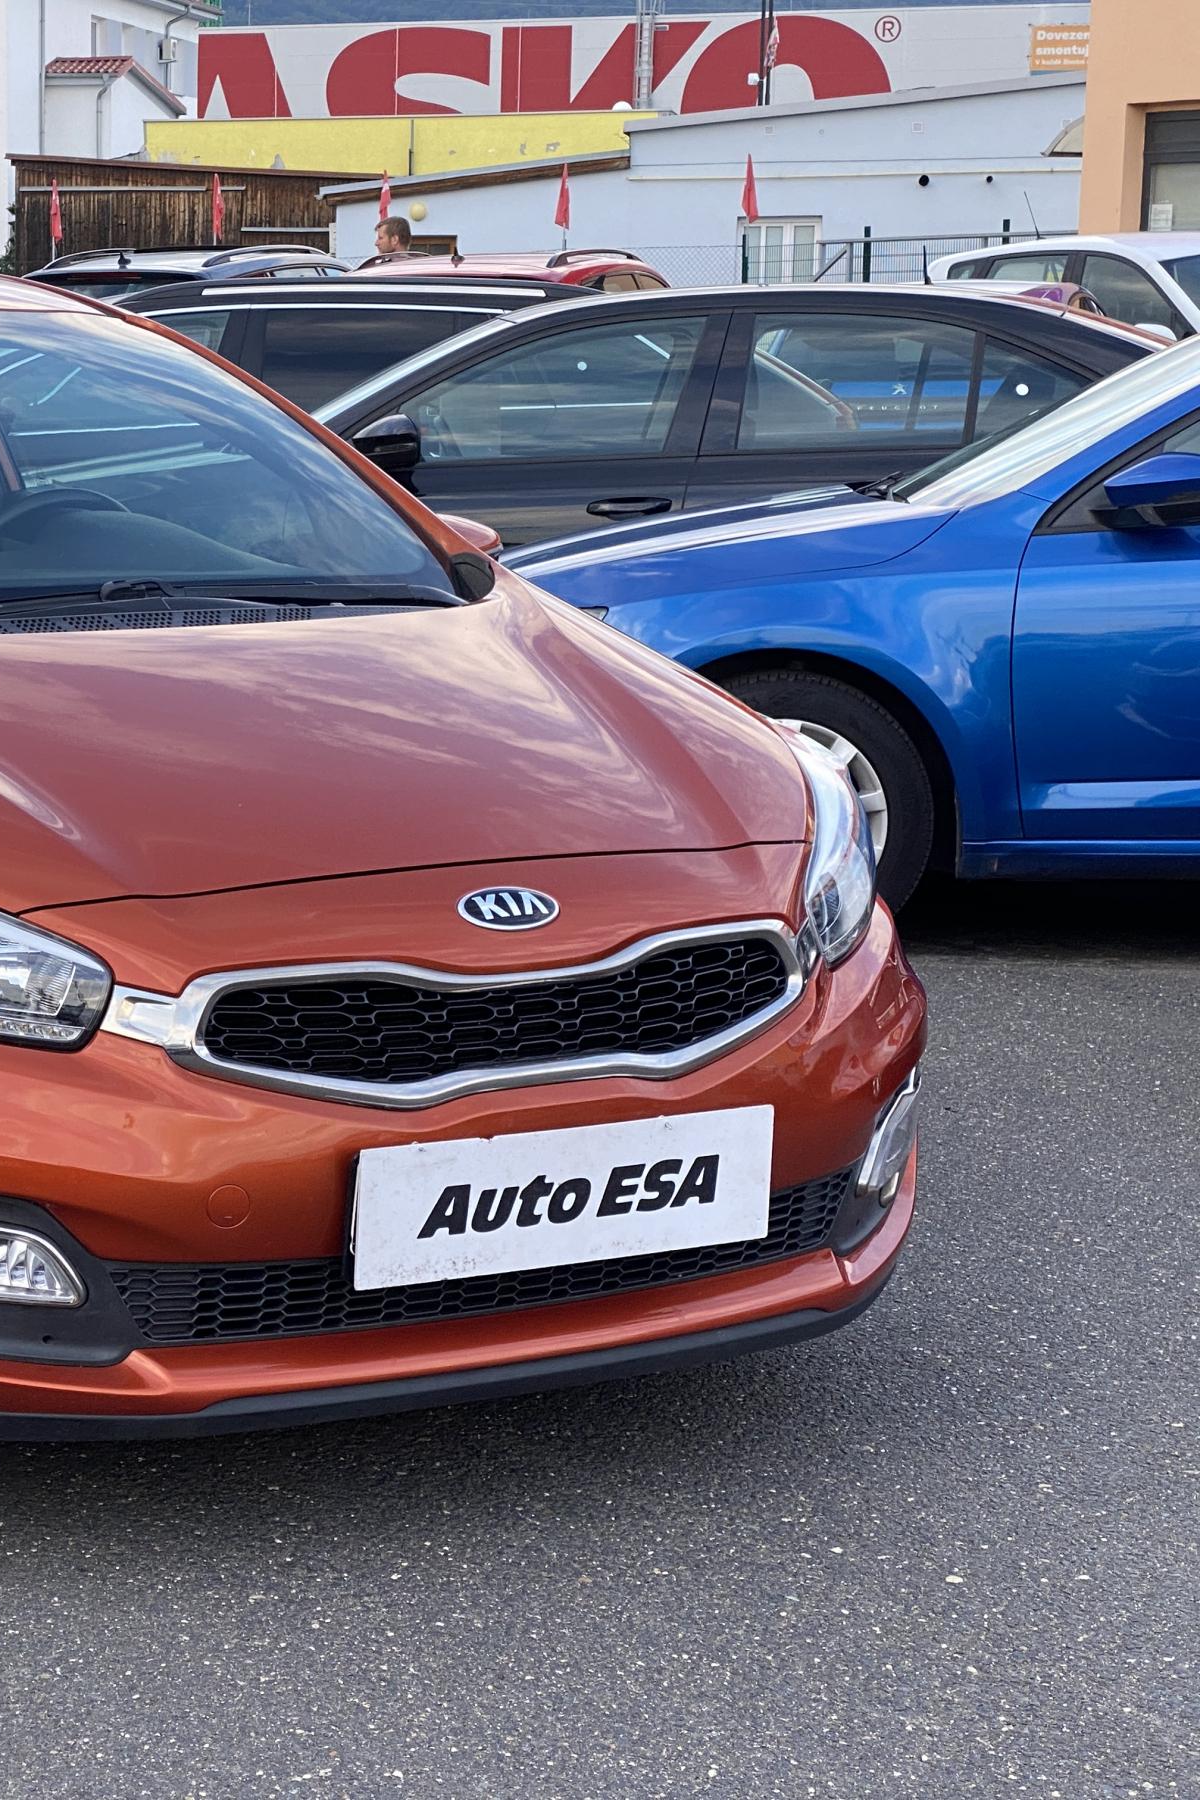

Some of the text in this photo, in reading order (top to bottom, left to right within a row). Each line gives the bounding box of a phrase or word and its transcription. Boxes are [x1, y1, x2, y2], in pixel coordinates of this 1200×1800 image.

[471, 891, 550, 921] KIA
[417, 1153, 721, 1240] Auto ESA
